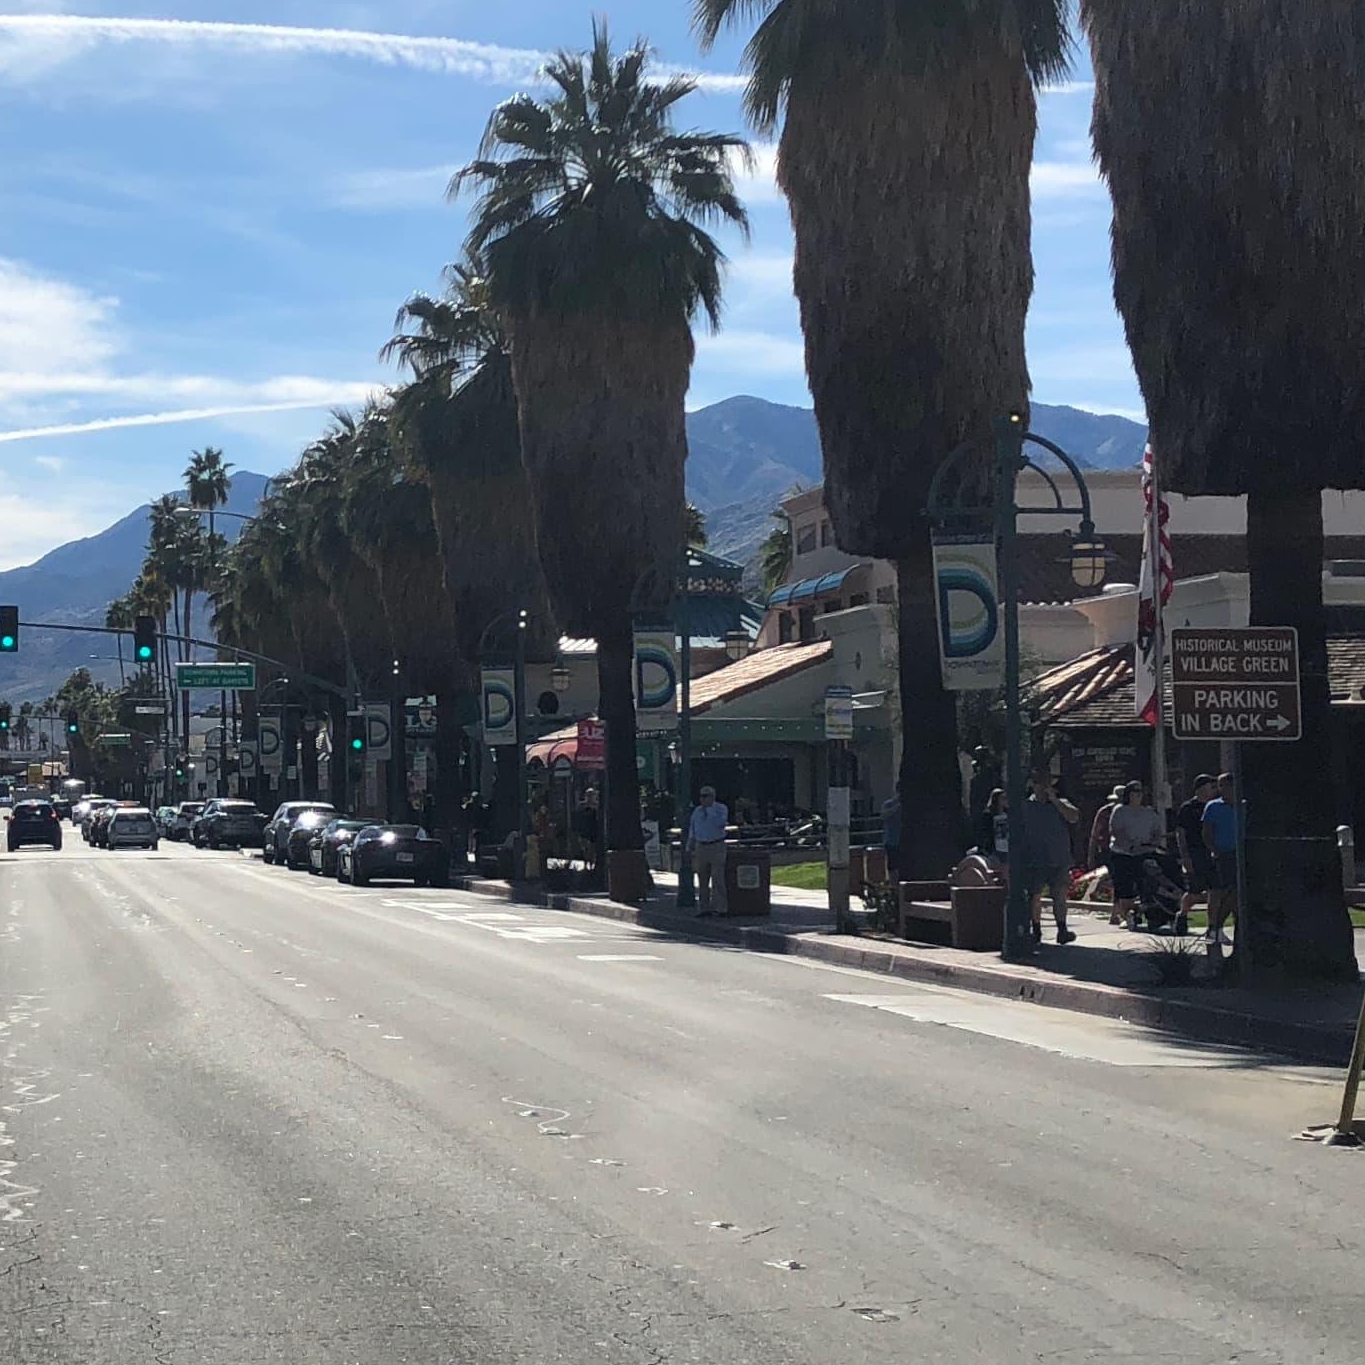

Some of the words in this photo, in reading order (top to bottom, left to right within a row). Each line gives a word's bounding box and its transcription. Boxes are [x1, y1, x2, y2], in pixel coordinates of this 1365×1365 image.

[939, 565, 998, 658] D
[1176, 638, 1239, 652] HISTORICAL
[1243, 638, 1292, 652] MUSEUM
[1180, 656, 1237, 672] VILLAGE
[1242, 656, 1289, 672] GREEN
[1194, 690, 1279, 709] PARKING
[1181, 714, 1200, 732] IN
[1210, 714, 1263, 732] BACK
